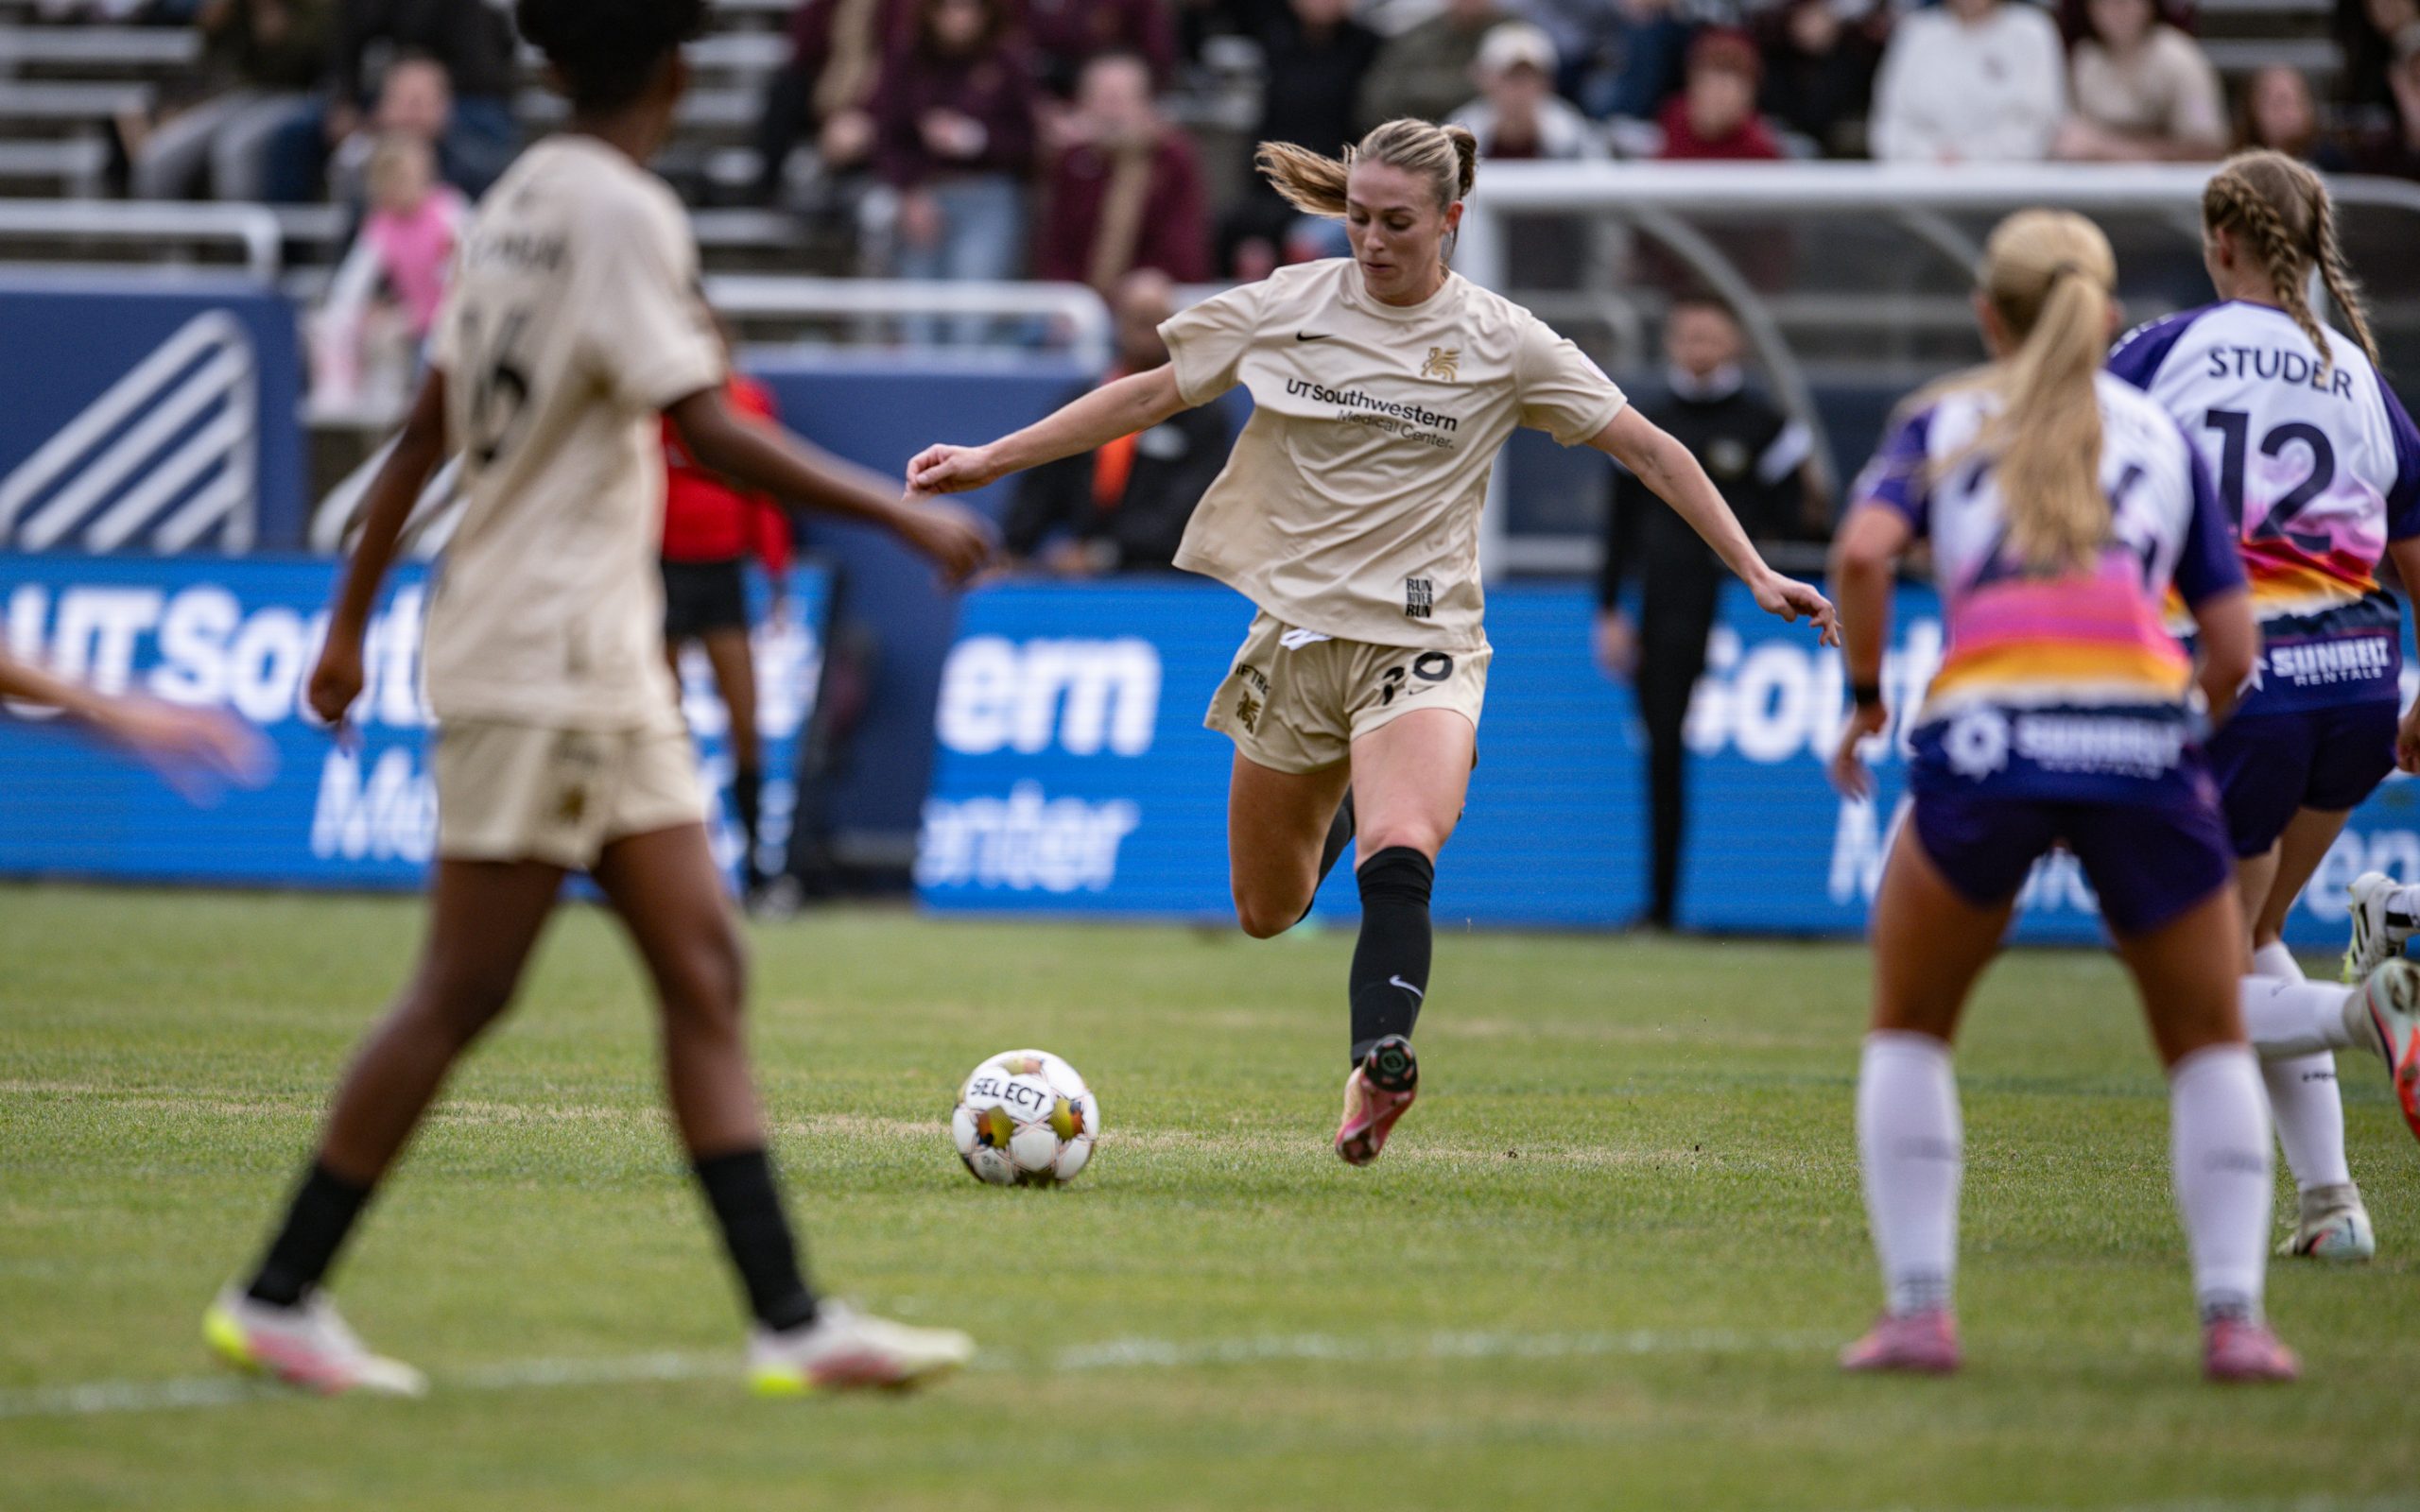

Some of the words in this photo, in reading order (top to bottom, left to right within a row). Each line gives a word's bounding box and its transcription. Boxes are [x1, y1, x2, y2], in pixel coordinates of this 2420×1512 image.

[2208, 347, 2352, 401] STUDER
[1286, 378, 1459, 432] UTSouthwestern
[1337, 408, 1397, 433] Medical
[2205, 408, 2334, 553] 12
[1406, 577, 1432, 592] RUN
[1405, 604, 1431, 618] RUN
[2271, 636, 2390, 678] SUNBELT
[2293, 666, 2382, 687] RENTALS
[970, 1077, 1046, 1111] SELECT
